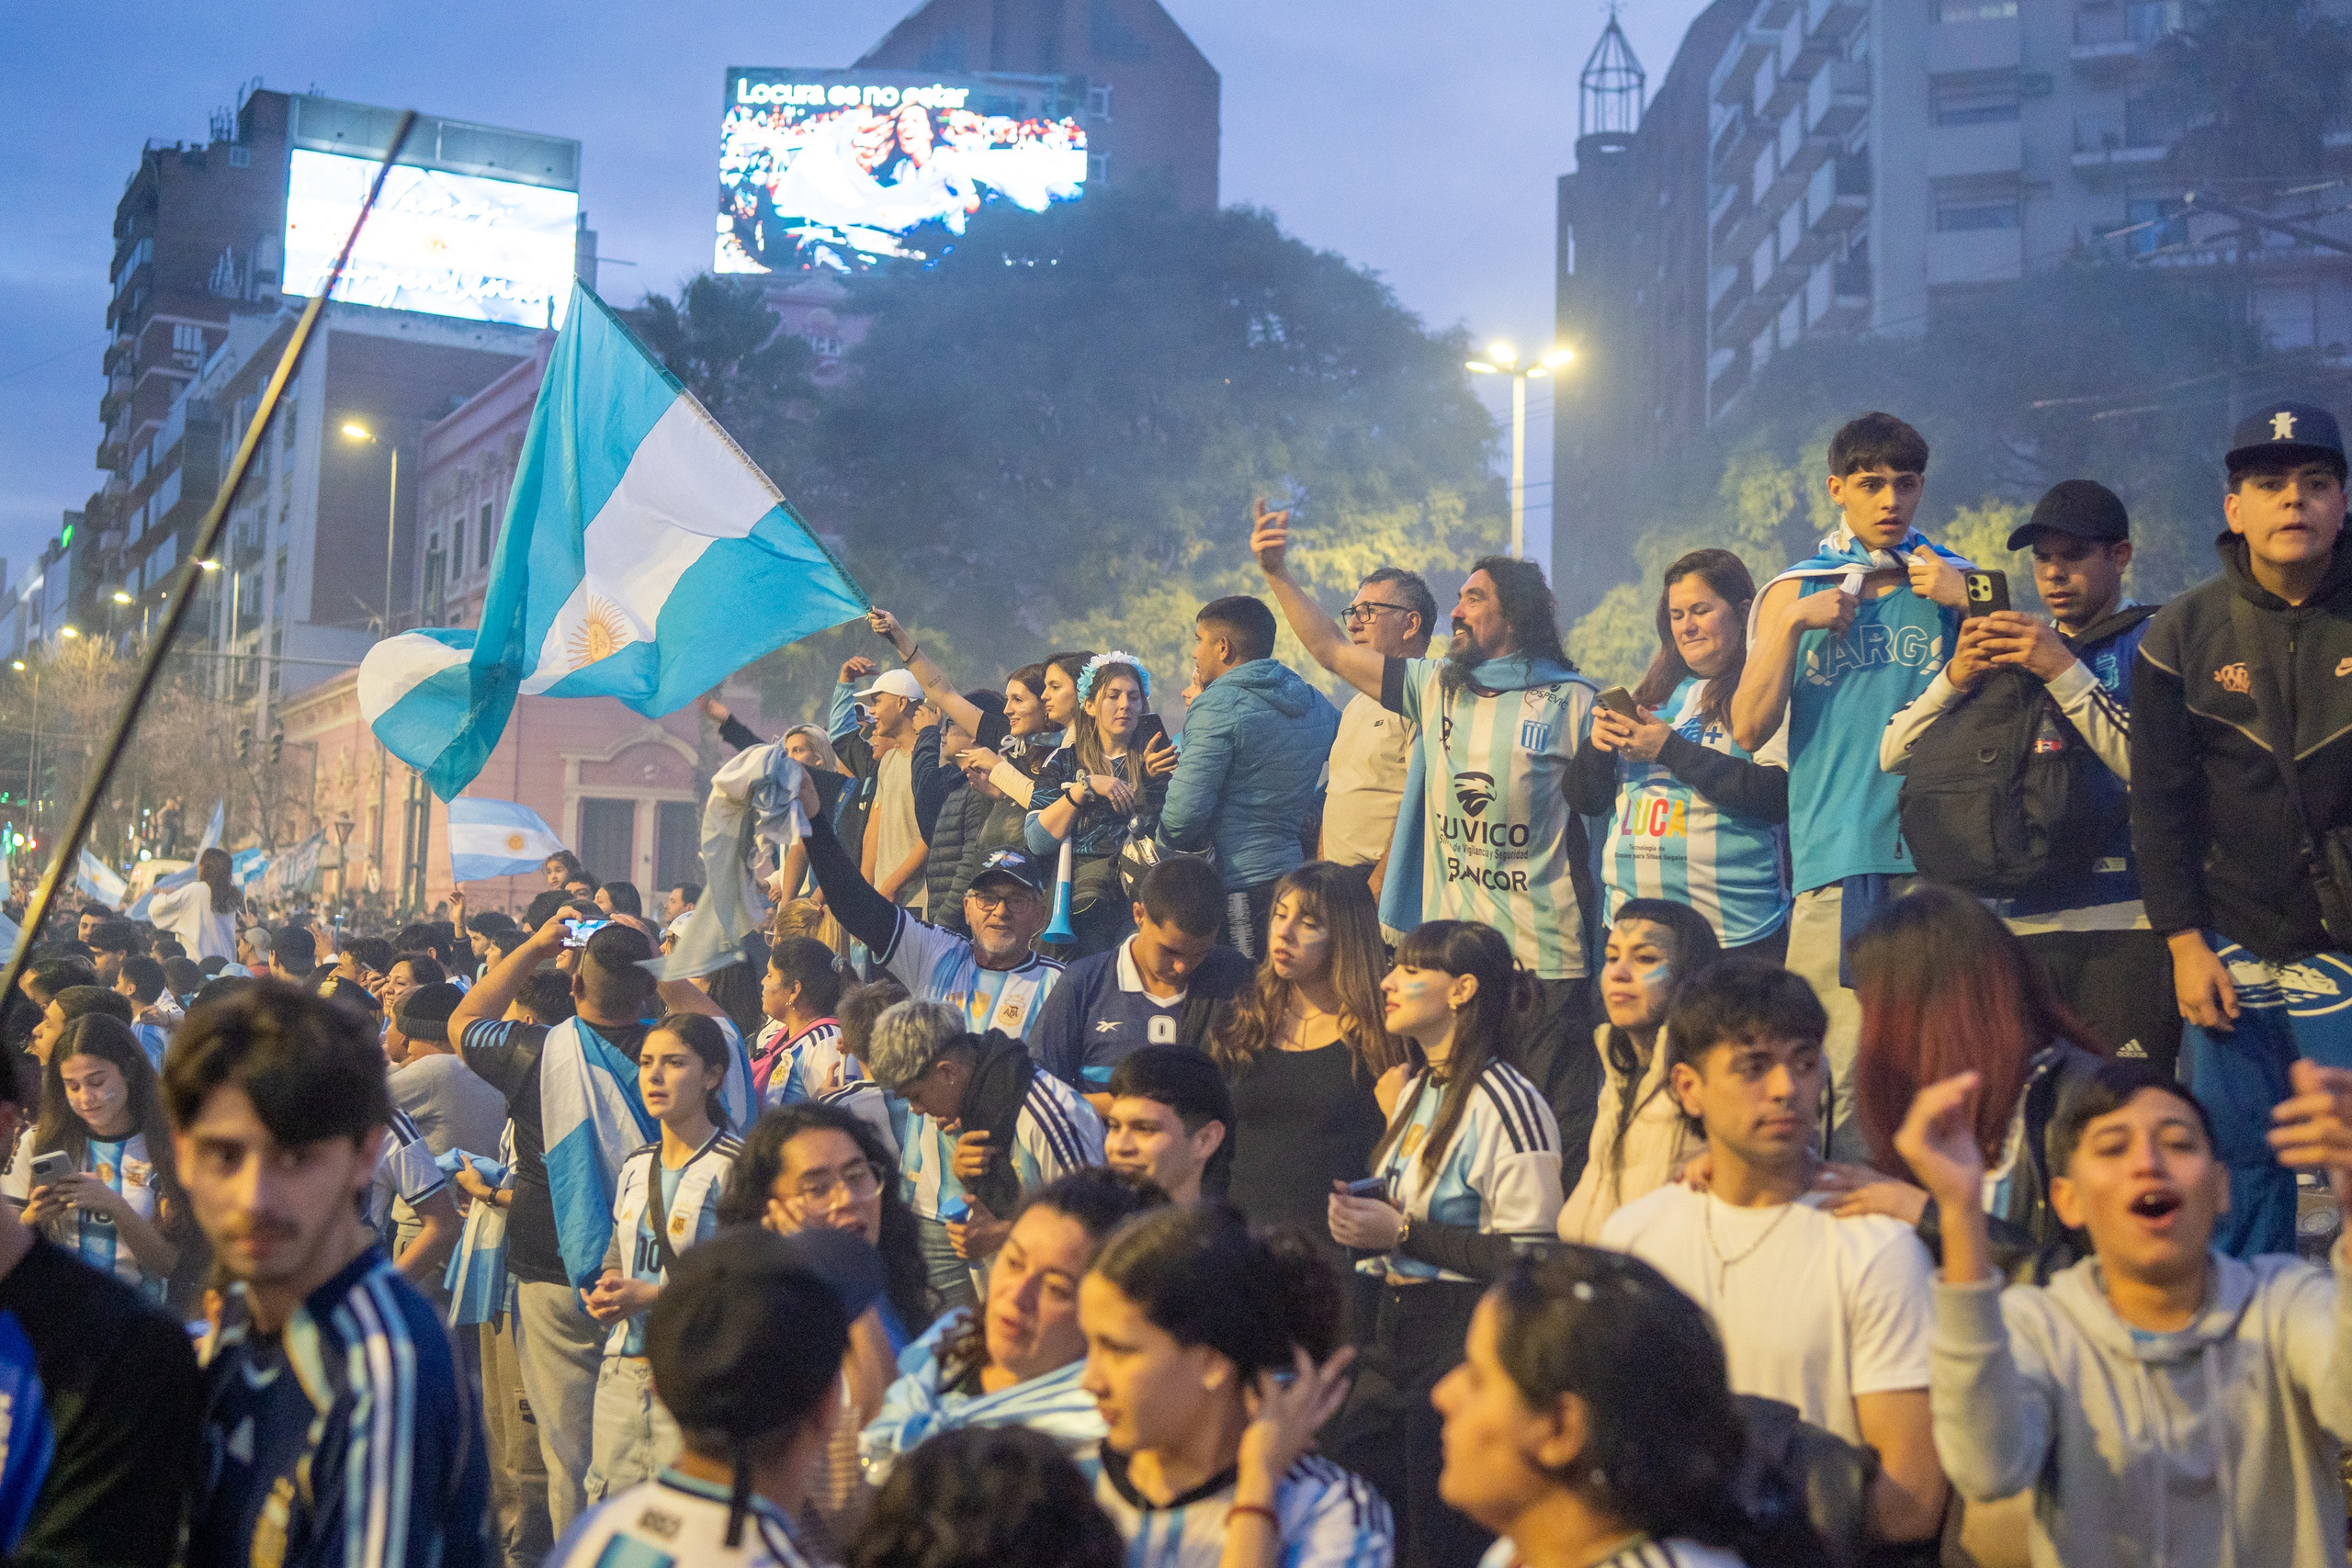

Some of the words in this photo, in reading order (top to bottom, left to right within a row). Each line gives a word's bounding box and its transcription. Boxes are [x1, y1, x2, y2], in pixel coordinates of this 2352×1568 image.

[736, 77, 826, 106] Locura
[827, 85, 861, 107] es
[863, 85, 899, 107] no
[900, 83, 969, 109] estar
[1826, 624, 1928, 680] ARG
[1436, 813, 1530, 847] UVICO
[1621, 798, 1688, 838] LUCA
[1494, 849, 1529, 862] Seguridad
[638, 1235, 662, 1274] 10
